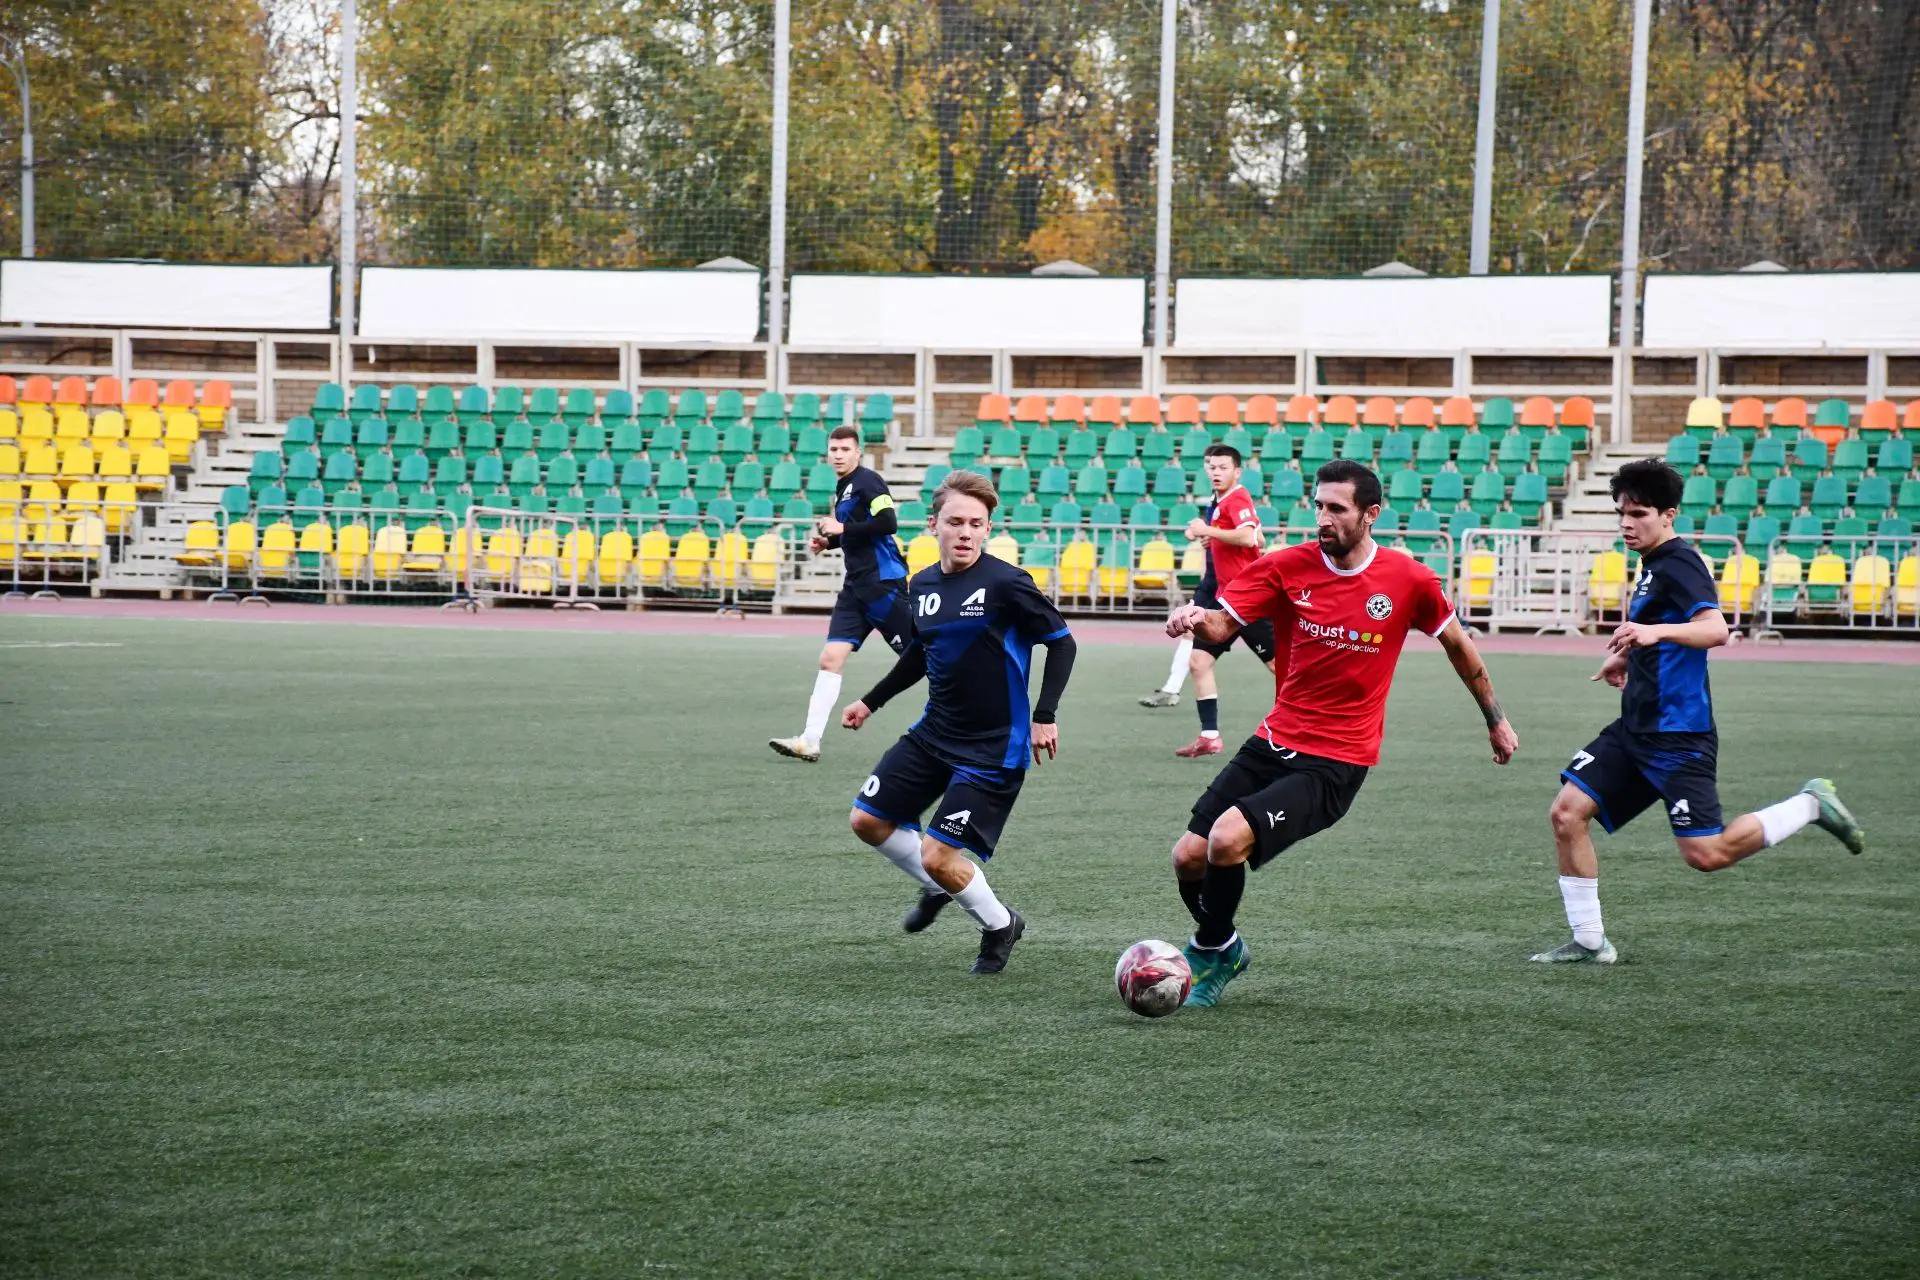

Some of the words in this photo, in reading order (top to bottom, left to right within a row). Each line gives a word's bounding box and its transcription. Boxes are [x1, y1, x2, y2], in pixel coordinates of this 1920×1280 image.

[918, 592, 941, 616] 10
[1298, 617, 1345, 639] avgust
[1336, 641, 1380, 654] protection
